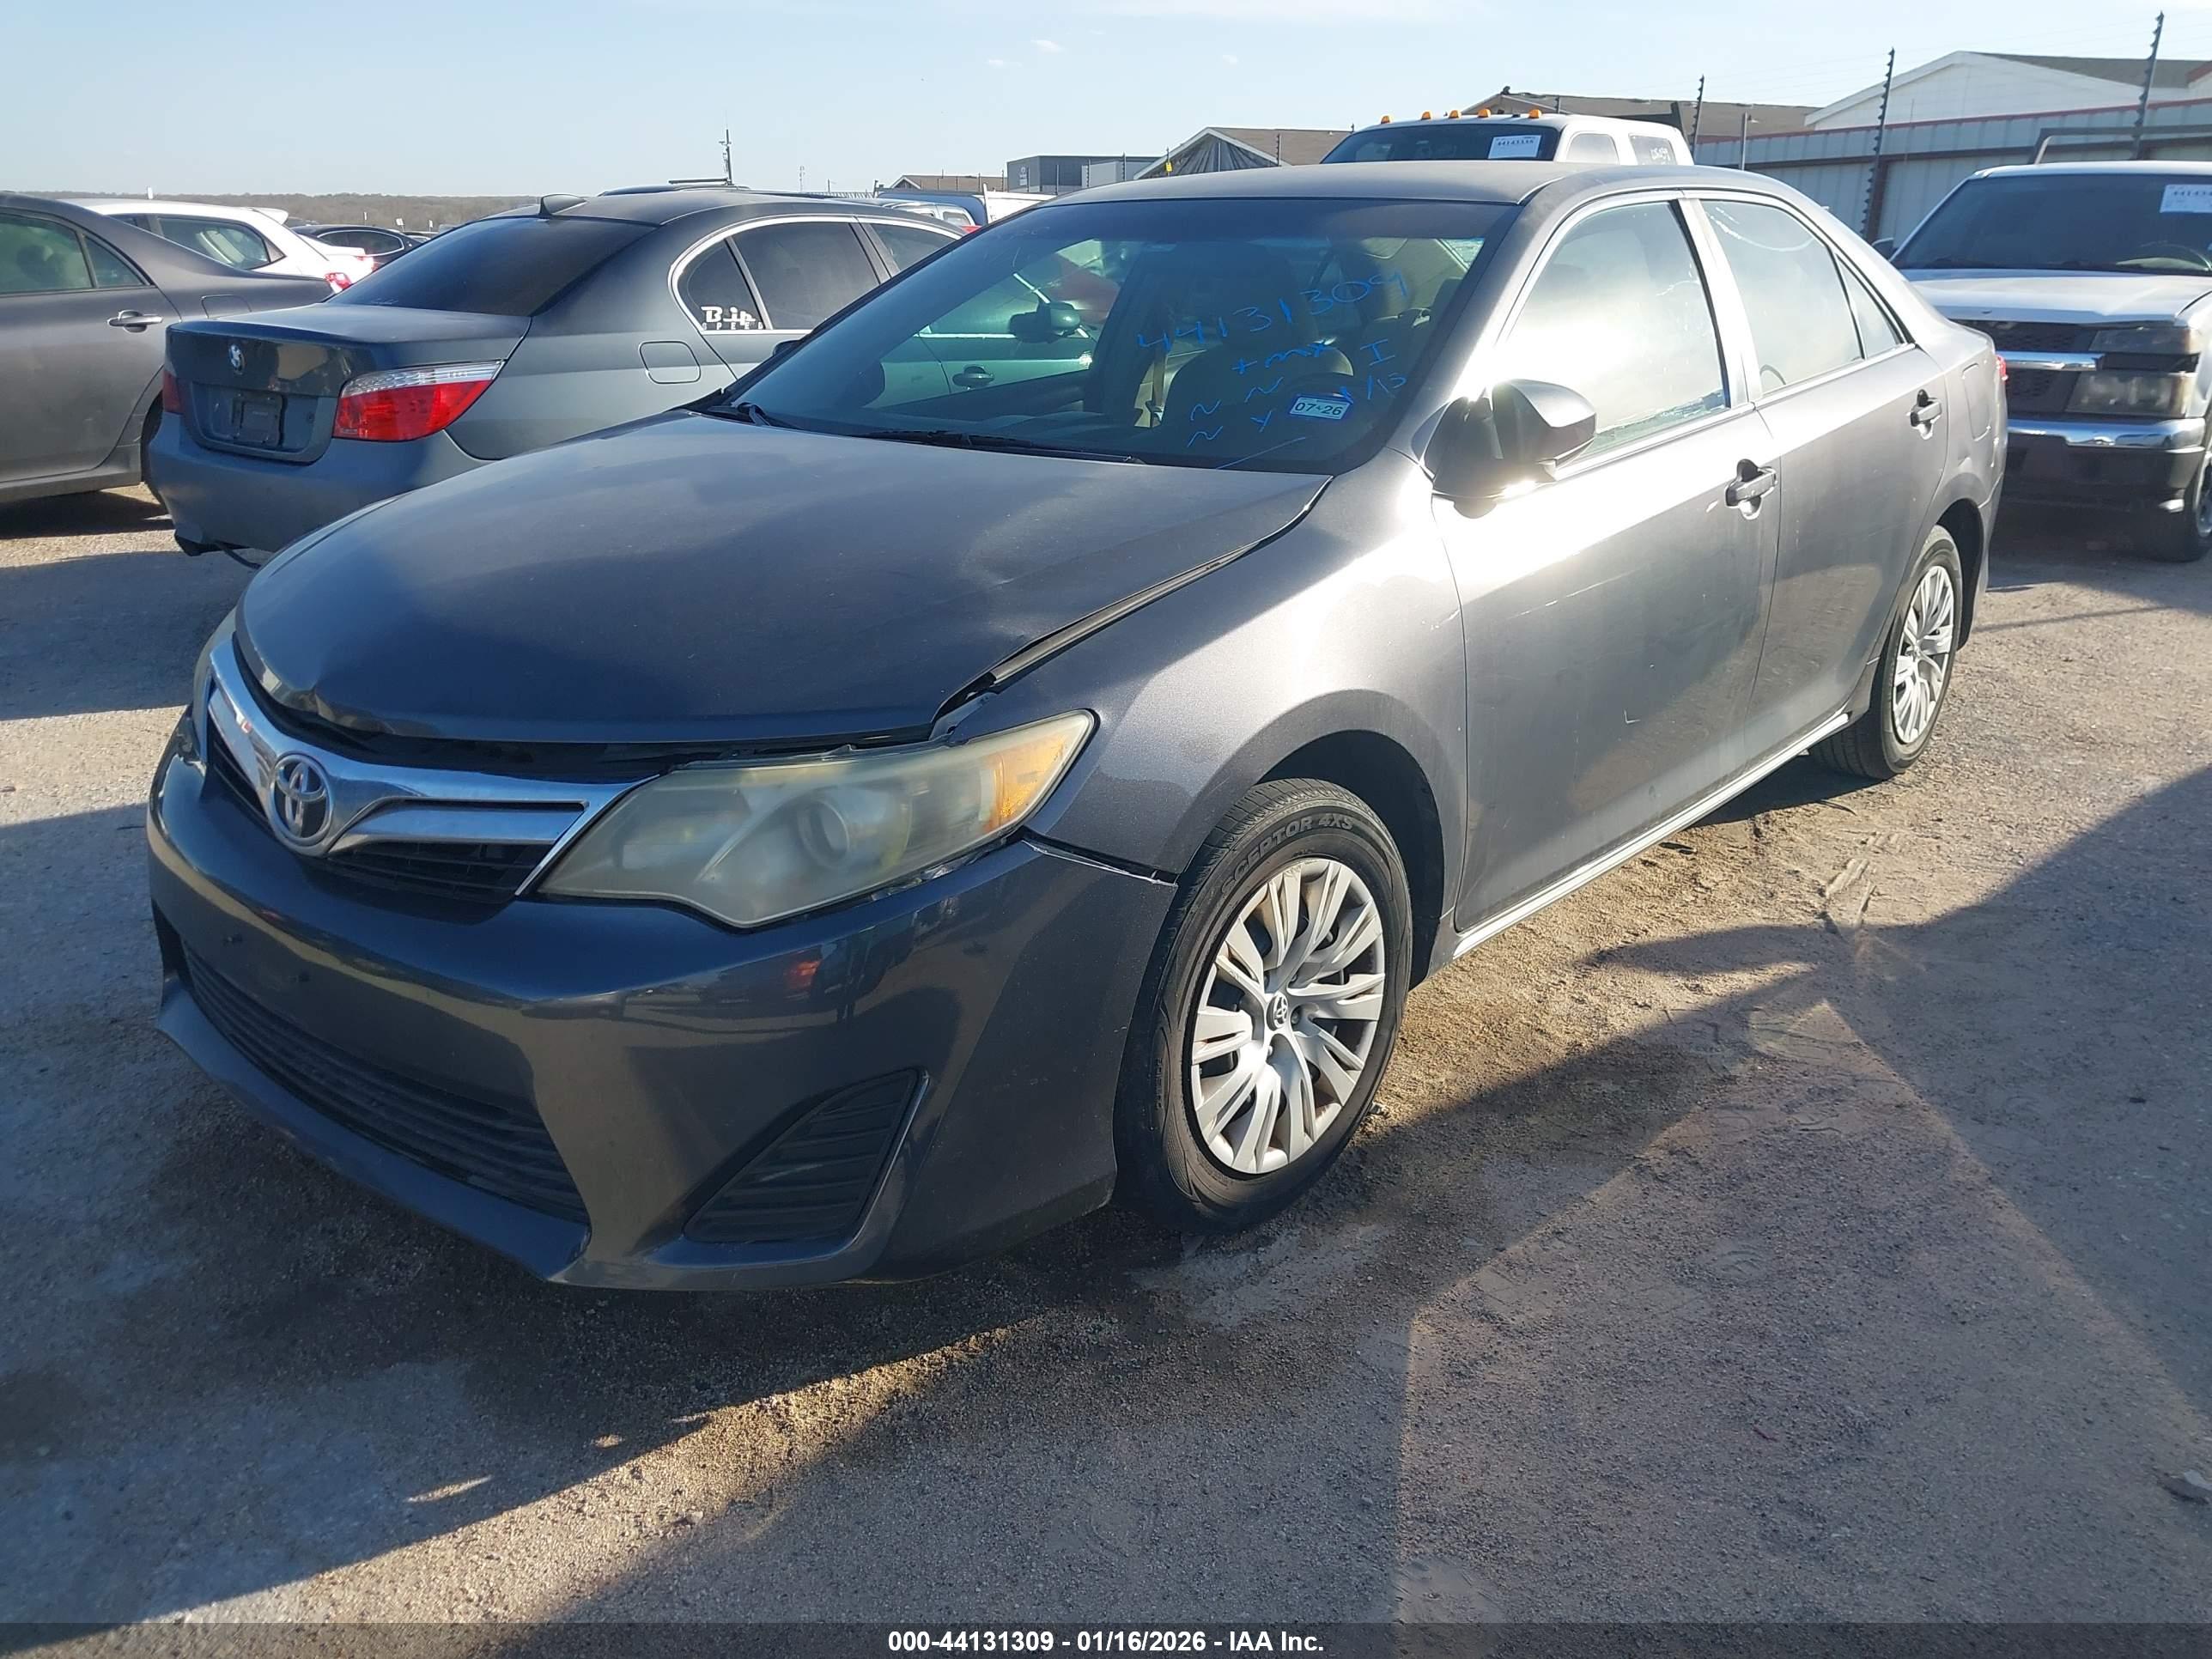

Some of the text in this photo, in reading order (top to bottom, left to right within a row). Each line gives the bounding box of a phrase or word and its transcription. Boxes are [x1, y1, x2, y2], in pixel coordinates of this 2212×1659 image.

[1137, 272, 1407, 351] 44131309
[1220, 812, 1354, 893] SCEPTOR 4XS
